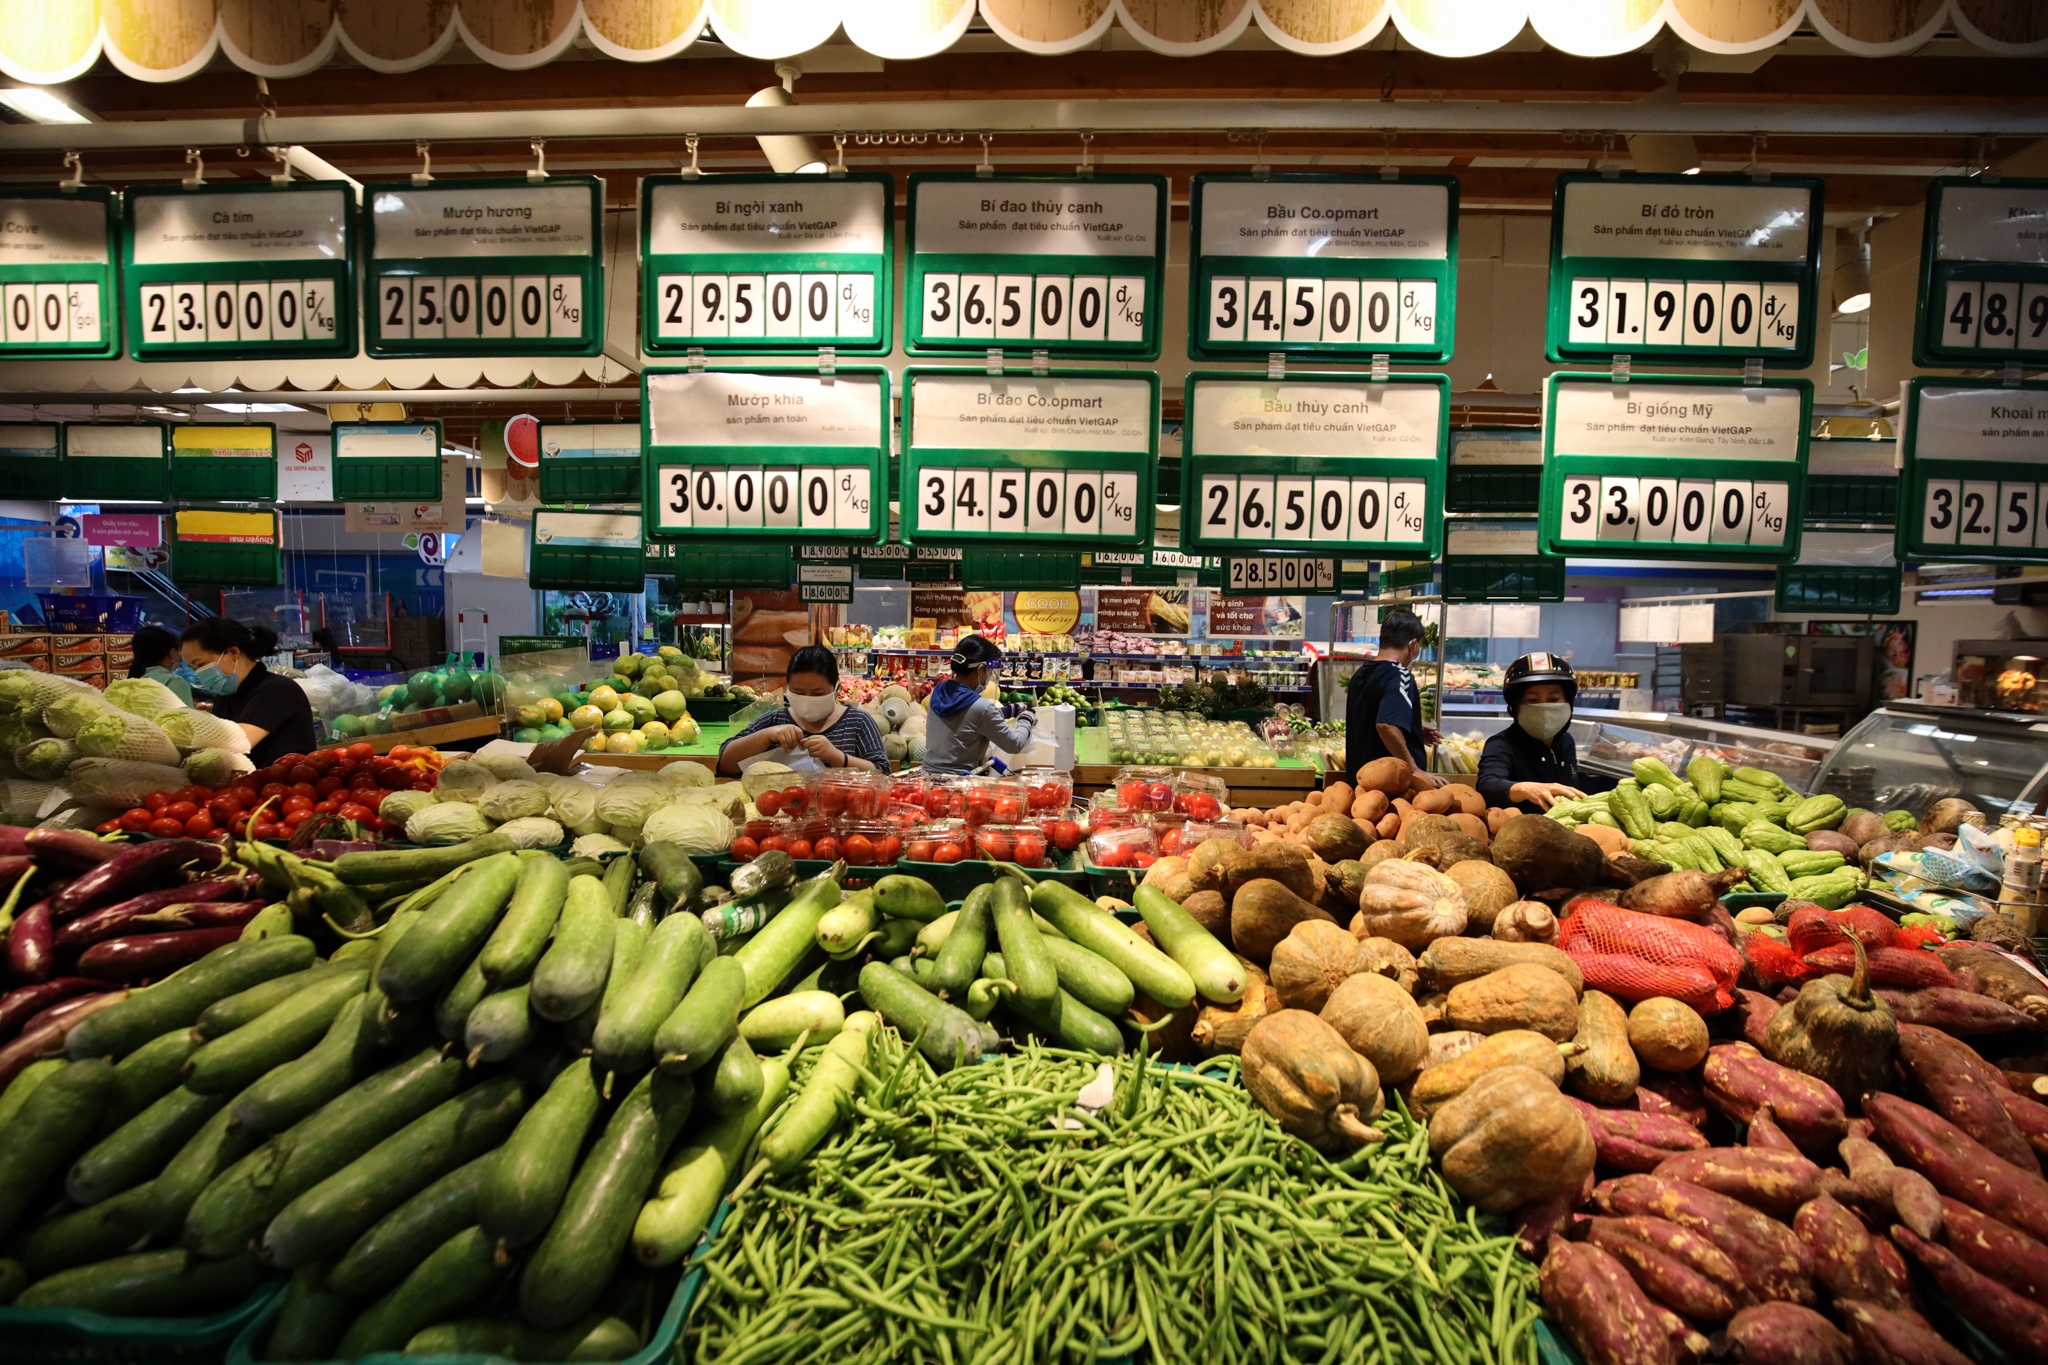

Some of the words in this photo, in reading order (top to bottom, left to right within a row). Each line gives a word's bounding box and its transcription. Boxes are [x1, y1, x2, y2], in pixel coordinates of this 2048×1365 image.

[443, 207, 483, 220] Mướp
[487, 207, 532, 219] hương
[717, 202, 730, 214] Bí
[735, 201, 764, 216] ngòi
[770, 201, 803, 213] xanh
[981, 200, 996, 212] Bí
[1000, 200, 1027, 213] đao
[1031, 200, 1063, 215] thủy
[1068, 201, 1103, 213] canh
[1267, 204, 1296, 219] Bầu
[1301, 207, 1379, 222] Co.opmart
[1642, 205, 1657, 217] Bí
[1661, 205, 1679, 218] đỏ
[1684, 206, 1714, 219] tròn
[213, 212, 230, 224] Cà
[233, 212, 253, 223] tím
[459, 226, 475, 237] đạt
[476, 226, 492, 235] tiêu
[524, 225, 561, 234] VietGAP
[730, 222, 746, 232] đạt
[748, 222, 765, 231] tiêu
[799, 222, 837, 230] VietGAP
[959, 220, 978, 230] Sản
[980, 220, 1007, 231] phẩm
[1012, 221, 1027, 232] đạt
[1030, 221, 1048, 231] tiêu
[1050, 221, 1080, 231] chuẩn
[1082, 222, 1123, 232] VietGAP
[1240, 228, 1259, 237] Sản
[1261, 227, 1289, 238] phẩm
[1291, 228, 1307, 239] đạt
[1310, 228, 1328, 237] tiêu
[1330, 228, 1361, 237] chuẩn
[1363, 229, 1405, 238] VietGAP
[1594, 225, 1613, 234] Sản
[1615, 225, 1643, 236] phẩm
[1645, 226, 1662, 238] đạt
[1664, 227, 1683, 237] tiêu
[1685, 227, 1715, 237] chuẩn
[386, 284, 541, 326] 25.000
[553, 283, 579, 322] đ/kg
[665, 281, 828, 323] 29.500
[843, 284, 870, 322] đ/kg
[931, 282, 1100, 328] 36.500
[1116, 285, 1144, 326] đ/kg
[149, 290, 297, 332] 23.000
[307, 289, 334, 332] đ/kg
[1216, 287, 1390, 333] 34.500
[1404, 291, 1432, 331] đ/kg
[1578, 288, 1753, 334] 31.900
[1765, 295, 1794, 340] đ/kg
[728, 394, 770, 408] Mướp
[775, 394, 804, 405] khía
[978, 393, 991, 405] Bí
[996, 393, 1023, 406] đao
[1028, 395, 1103, 410] Co.opmart
[1264, 399, 1292, 412] Bầu
[1297, 401, 1329, 416] thủy
[1333, 402, 1369, 414] canh
[1627, 403, 1642, 414] Bí
[1646, 401, 1687, 418] giống
[1693, 403, 1713, 419] Mỹ
[1991, 406, 2033, 419] Khoai
[787, 415, 808, 423] toàn
[959, 414, 977, 422] Sản
[980, 414, 1006, 424] phẩm
[1009, 415, 1024, 426] đạt
[1027, 415, 1045, 425] tiêu
[1047, 415, 1077, 425] chuẩn
[1079, 417, 1119, 426] VietGAP
[1234, 421, 1252, 430] Sản
[1284, 422, 1301, 433] đạt
[1303, 422, 1322, 431] tiêu
[1324, 421, 1354, 431] chuẩn
[1357, 423, 1396, 432] VietGAP
[1587, 423, 1604, 431] Sản
[1608, 422, 1635, 433] phẩm
[1640, 424, 1656, 435] đạt
[1658, 424, 1676, 433] tiêu
[1679, 424, 1709, 434] chuẩn
[1712, 426, 1752, 435] VietGAP
[1982, 428, 2000, 437] sản
[2003, 427, 2030, 438] phẩm
[670, 471, 828, 516] 30.000
[842, 474, 868, 513] đ/kg
[925, 477, 1096, 523] 34.500
[1105, 481, 1132, 521] đ/kg
[1208, 485, 1379, 531] 26.500
[1394, 492, 1422, 531] đ/kg
[1571, 483, 1744, 531] 33.000
[1756, 492, 1782, 532] đ/kg
[1233, 562, 1314, 582] 28.500
[915, 606, 930, 614] Công
[932, 607, 946, 615] nghệ
[1217, 600, 1226, 608] vệ
[1023, 611, 1073, 625] Bakery
[1227, 611, 1238, 619] tốt
[1232, 623, 1251, 631] khỏe
